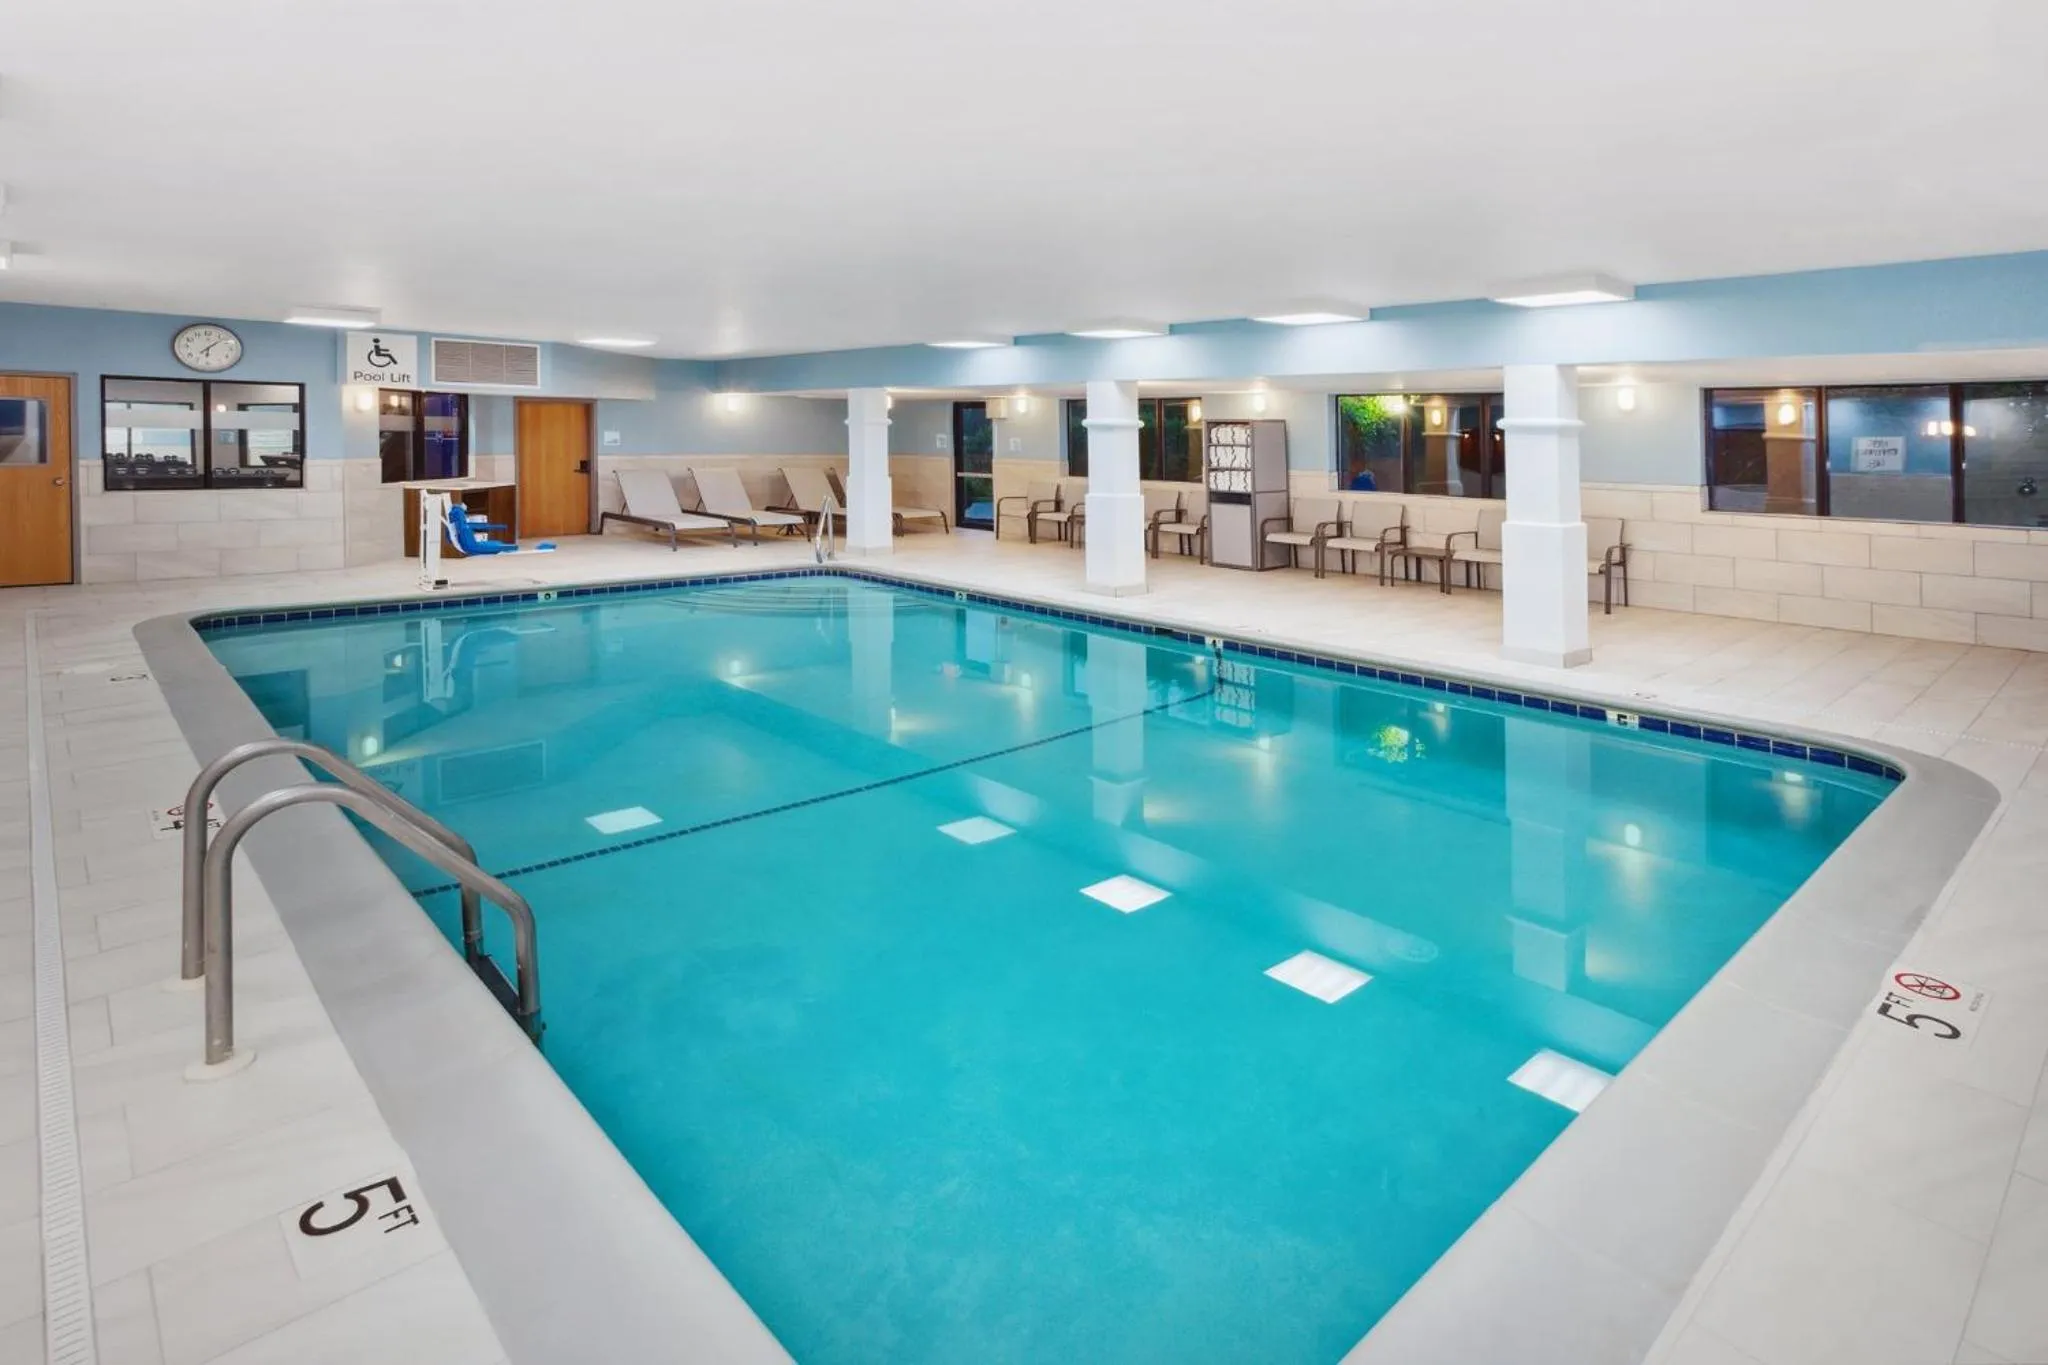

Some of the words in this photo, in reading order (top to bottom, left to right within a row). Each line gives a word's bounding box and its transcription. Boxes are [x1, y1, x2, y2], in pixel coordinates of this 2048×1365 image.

[353, 371, 385, 382] Pool
[390, 373, 411, 383] Lift
[1885, 992, 1914, 1008] FT
[1877, 1002, 1961, 1039] 5
[299, 1176, 407, 1236] 5
[378, 1204, 419, 1234] FT
